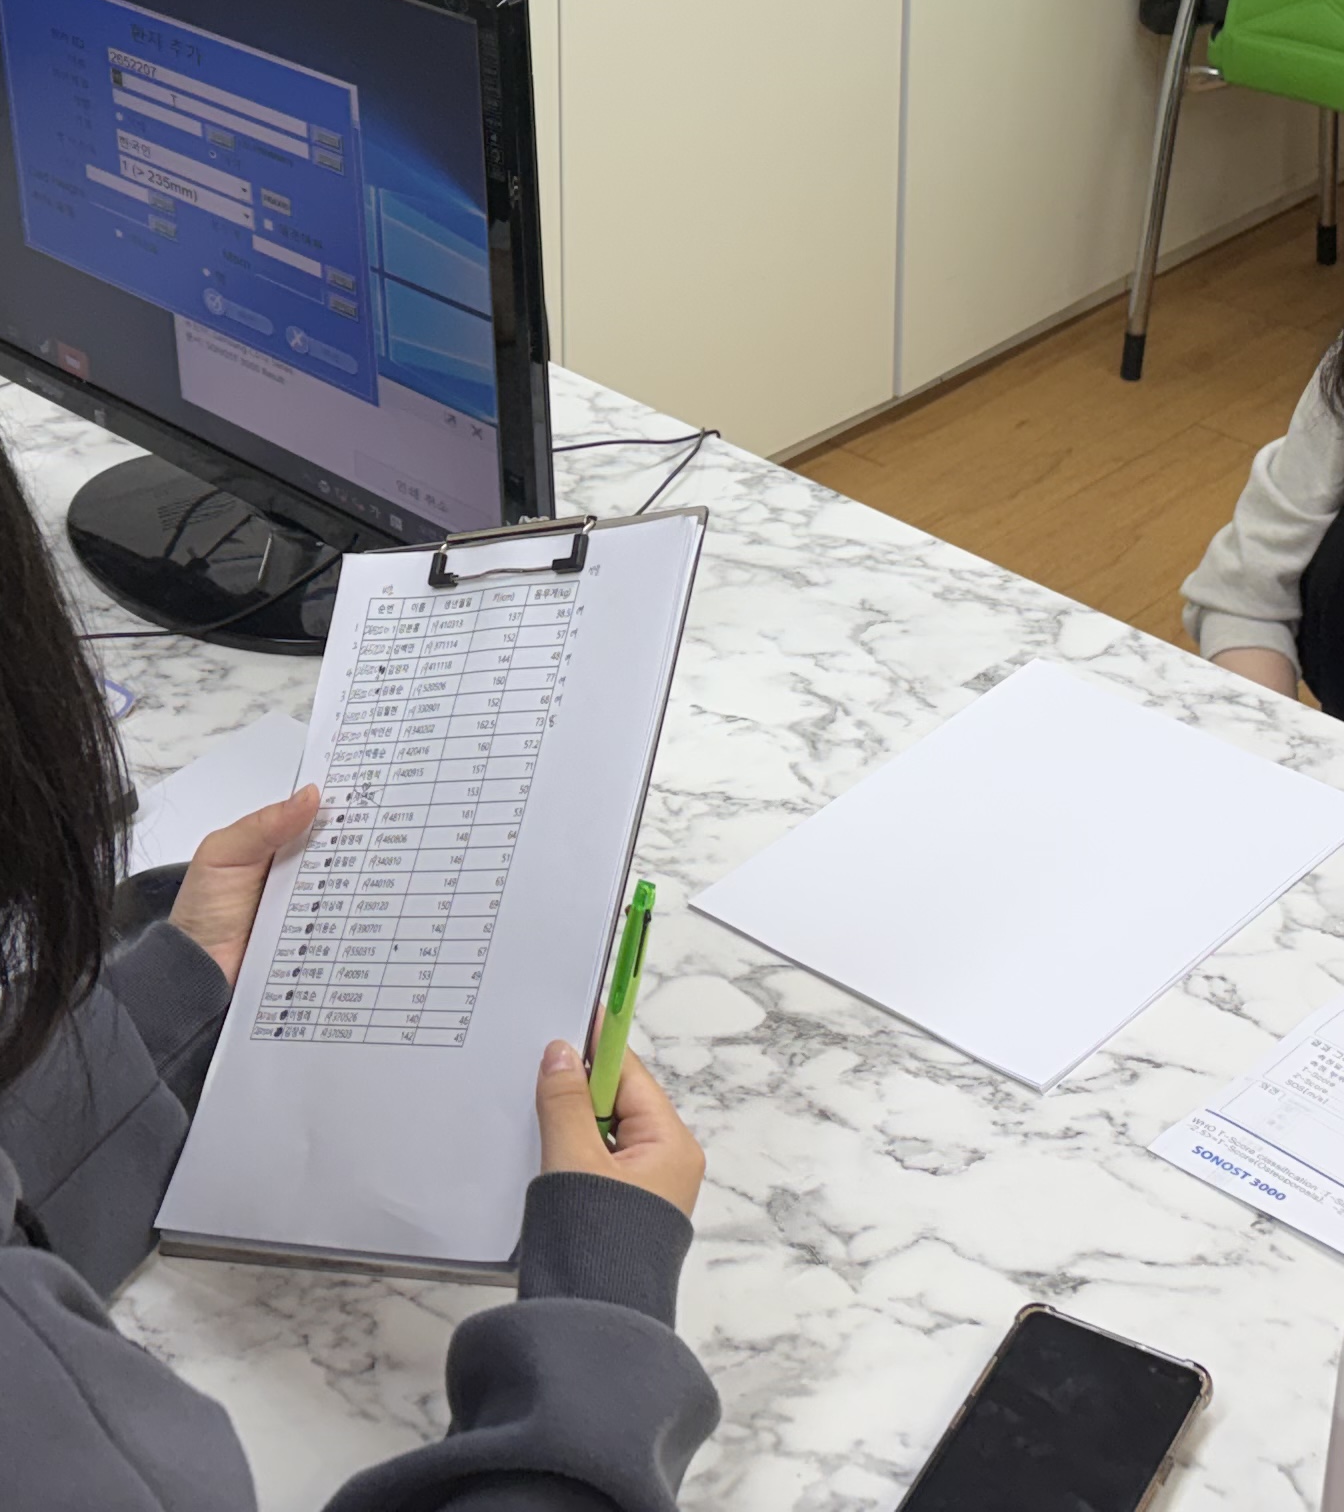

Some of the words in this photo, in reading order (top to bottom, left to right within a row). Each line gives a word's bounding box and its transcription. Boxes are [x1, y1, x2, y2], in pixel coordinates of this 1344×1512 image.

[171, 39, 201, 66] 추가
[109, 51, 156, 78] 2652207
[119, 136, 152, 159] 한국인
[122, 160, 128, 172] 1
[148, 170, 198, 202] 235mm)
[508, 612, 523, 622] 137
[503, 633, 516, 643] 152
[556, 629, 566, 640] 57
[546, 673, 555, 682] 77
[487, 698, 501, 707] 152
[476, 720, 495, 730] 162.5
[535, 717, 545, 727] 73
[477, 742, 490, 752] 160
[524, 740, 538, 750] 57.2
[472, 765, 485, 774] 157
[525, 762, 533, 771] 71
[467, 787, 479, 797] 153
[513, 808, 523, 817] 53
[501, 853, 510, 863] 51
[438, 901, 450, 910] 150
[418, 970, 431, 980] 153
[411, 994, 425, 1004] 150
[465, 994, 475, 1005] 72
[401, 1031, 414, 1041] 142
[454, 1033, 464, 1043] 45
[1192, 1116, 1216, 1133] WHO
[1218, 1128, 1256, 1155] T-Score
[1256, 1152, 1318, 1192] classification
[1192, 1144, 1252, 1181] SONOST
[1249, 1177, 1287, 1202] 3000
